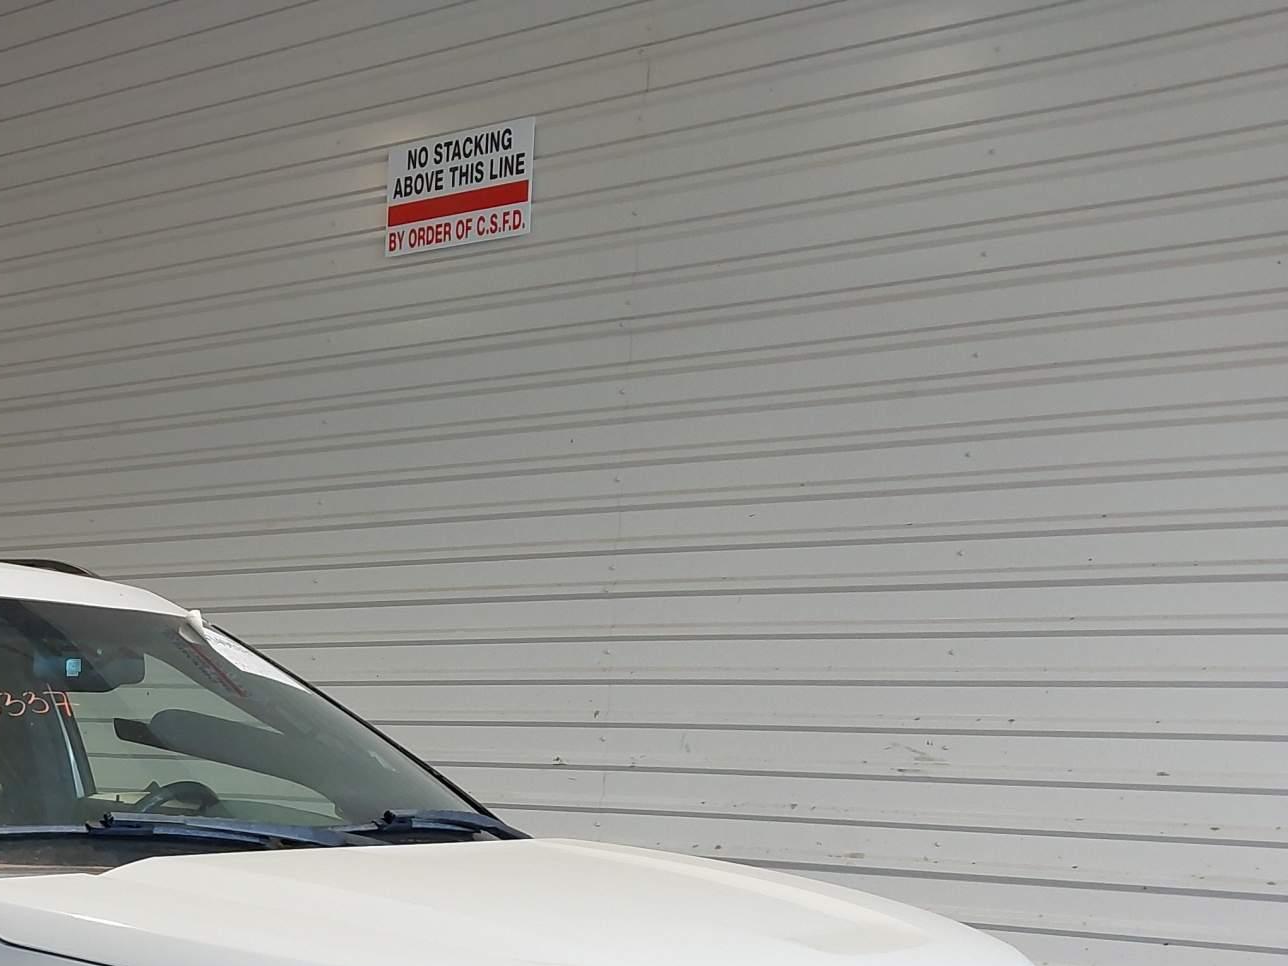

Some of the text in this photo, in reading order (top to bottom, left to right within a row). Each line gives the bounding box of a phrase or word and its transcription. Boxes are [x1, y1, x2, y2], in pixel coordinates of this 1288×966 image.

[407, 128, 512, 170] NO STACKING
[393, 153, 525, 199] ABOVE THIS LINE
[389, 209, 525, 252] BY ORDER OF C.S.F.D.
